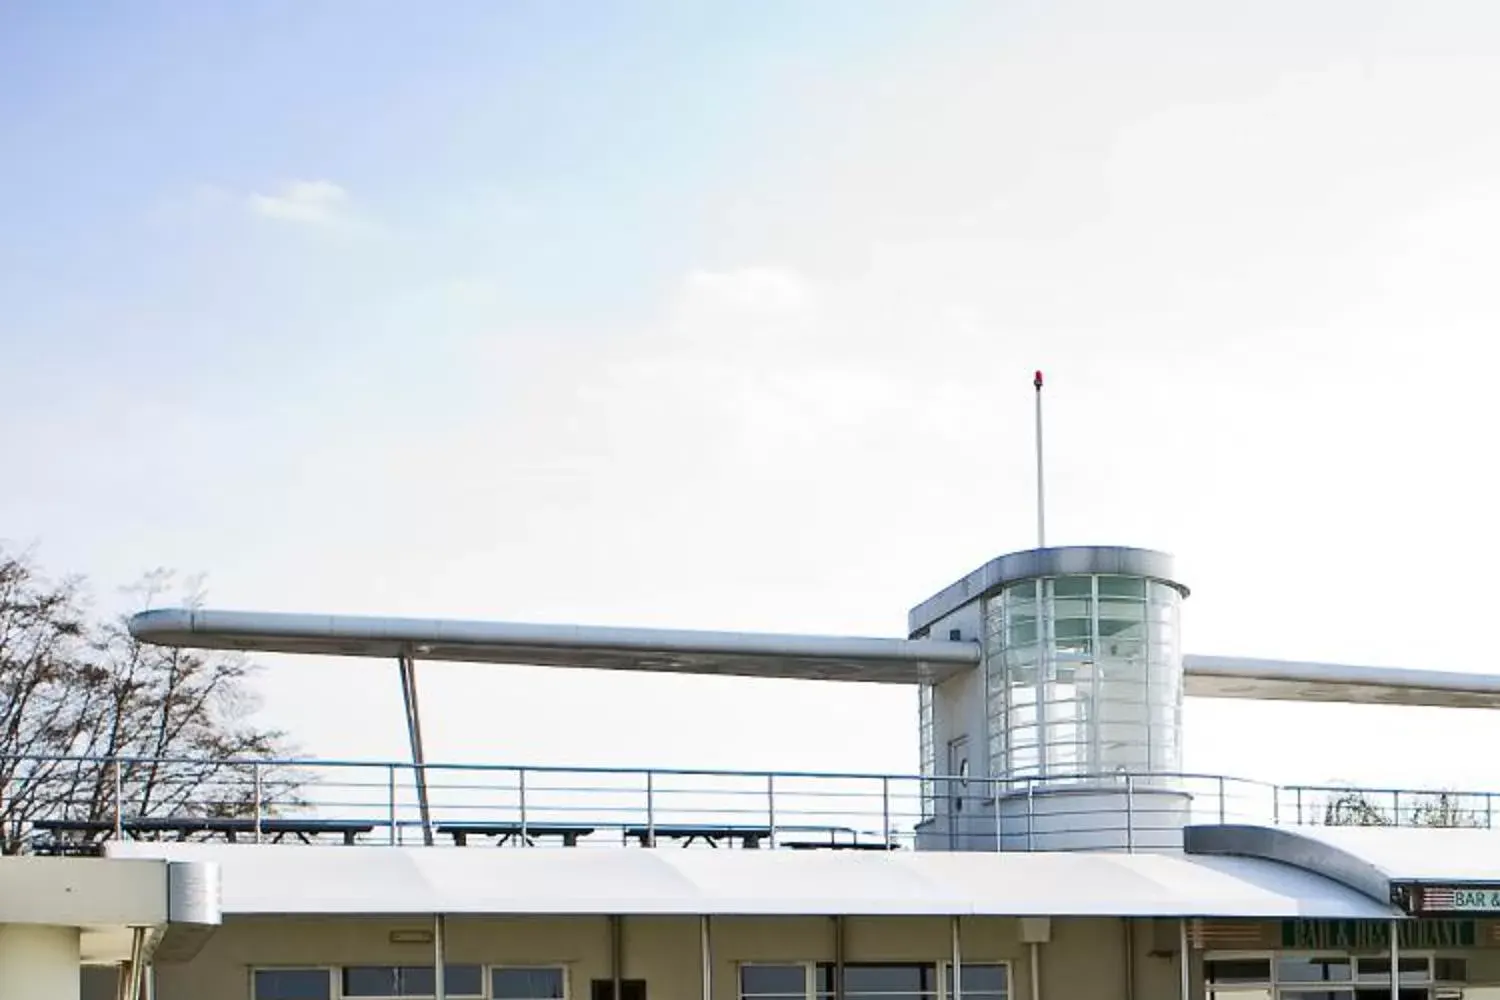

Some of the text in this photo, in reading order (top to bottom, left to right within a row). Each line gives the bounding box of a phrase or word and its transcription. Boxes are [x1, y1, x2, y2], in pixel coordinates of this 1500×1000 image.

[1454, 893, 1486, 907] BAR
[1491, 893, 1500, 908] &
[1355, 918, 1463, 947] RESAURANT
